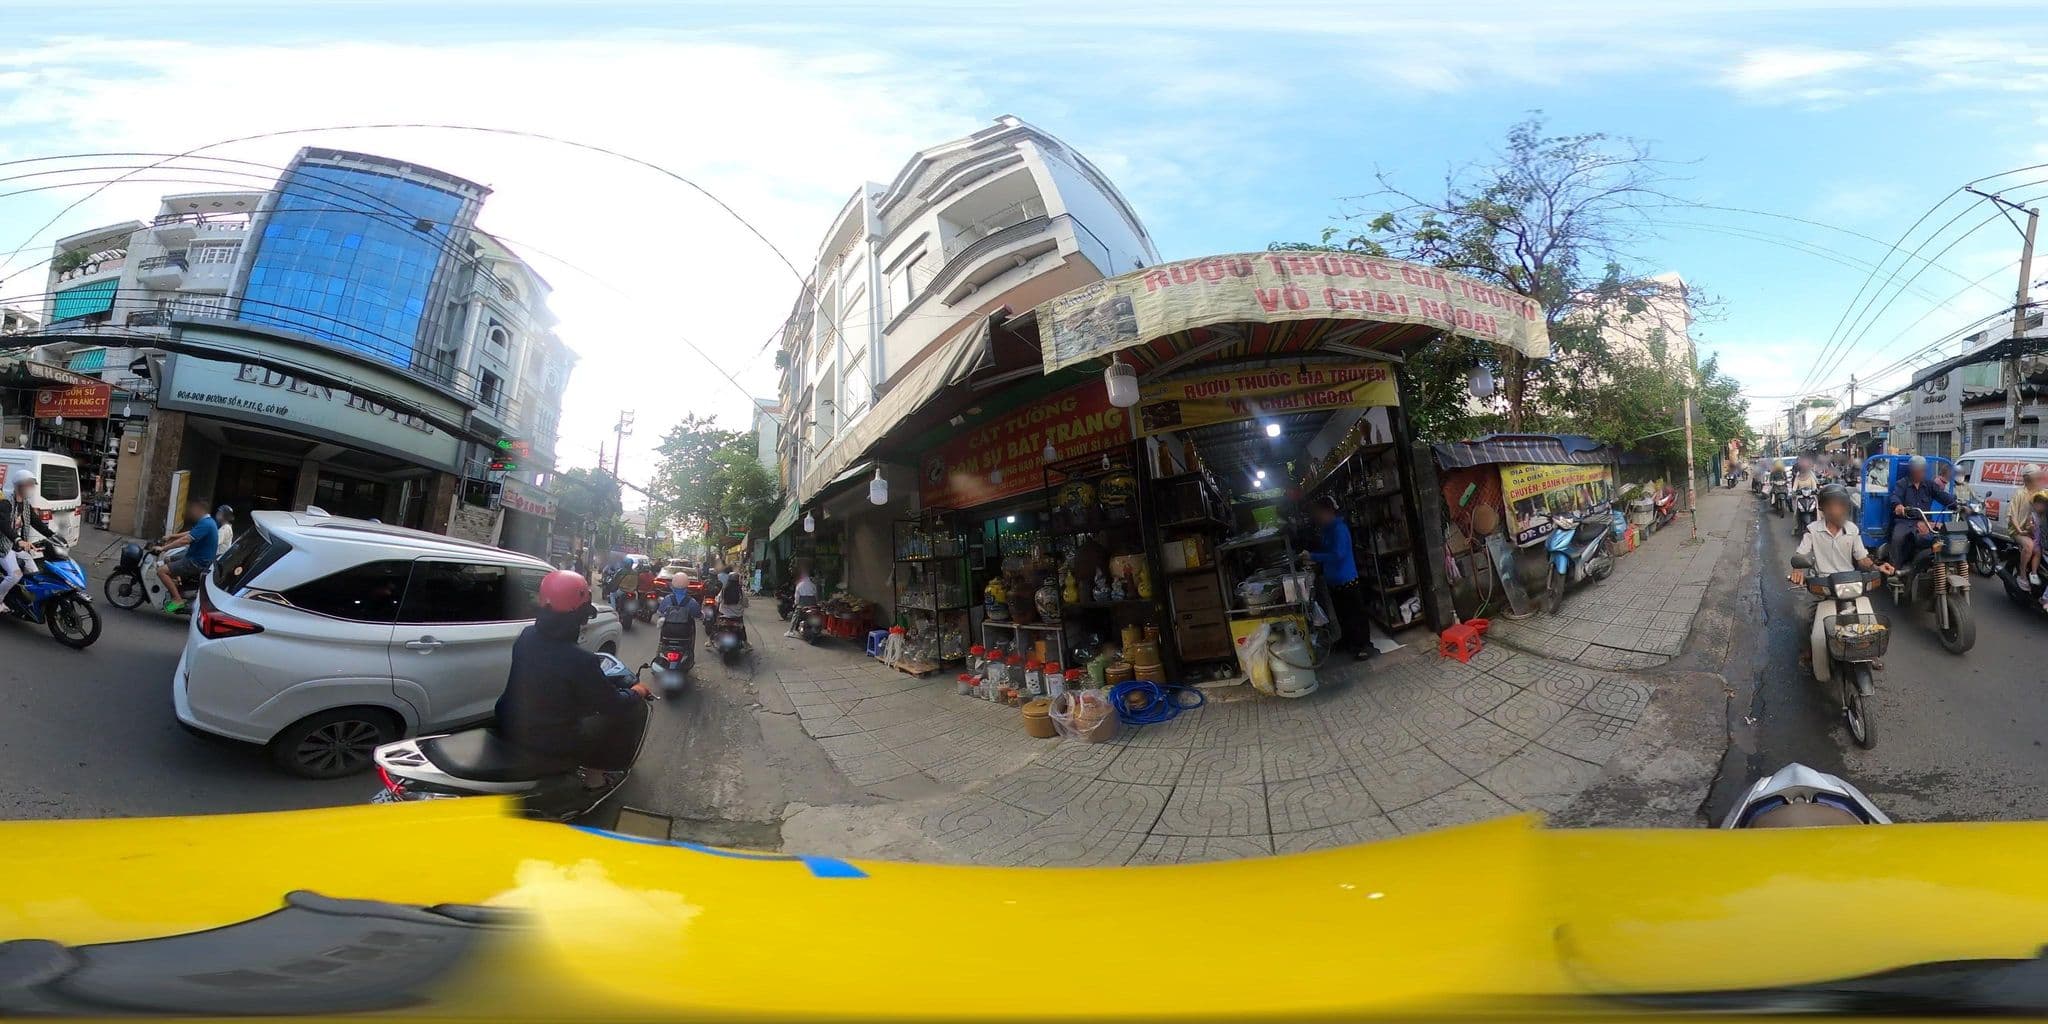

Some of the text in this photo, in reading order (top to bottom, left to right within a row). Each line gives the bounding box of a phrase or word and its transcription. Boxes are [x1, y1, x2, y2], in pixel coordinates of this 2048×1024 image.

[1401, 266, 1454, 294] GIA
[1322, 287, 1410, 315] CHAI
[1296, 370, 1325, 385] GIA
